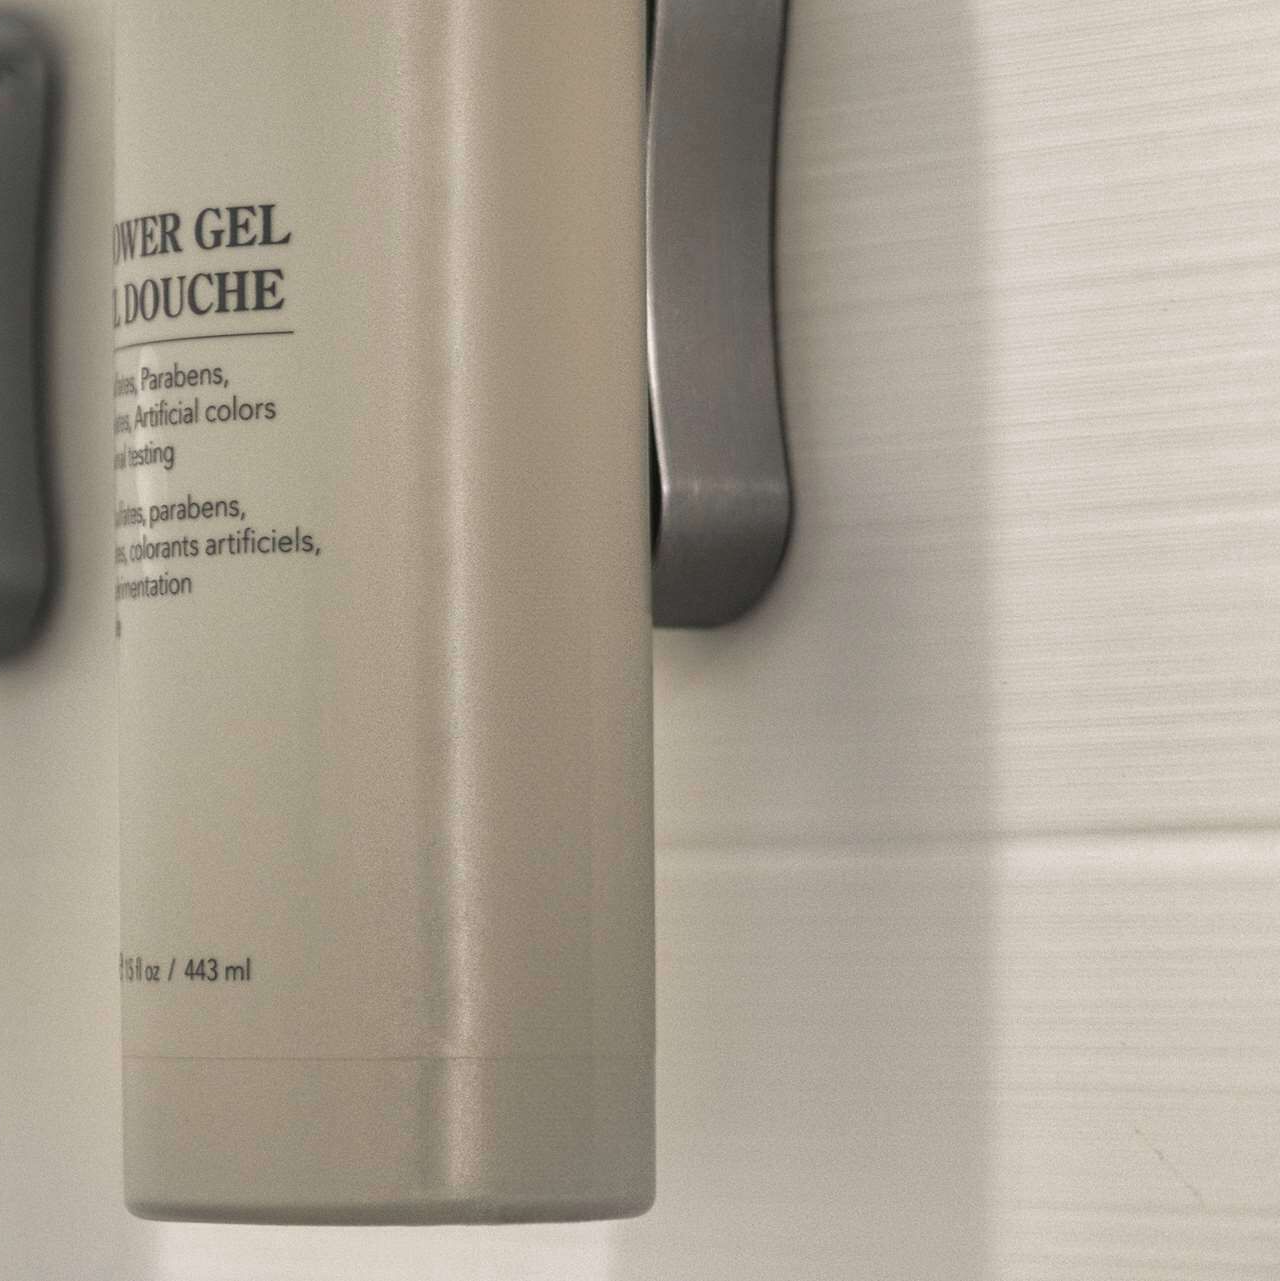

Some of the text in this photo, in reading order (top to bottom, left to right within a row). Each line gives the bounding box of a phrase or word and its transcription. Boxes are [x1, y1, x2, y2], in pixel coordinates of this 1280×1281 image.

[113, 203, 292, 265] OWER GEL
[124, 267, 285, 326] DOUCHE
[140, 362, 229, 391] Parabens,
[134, 397, 199, 431] Artificial
[205, 394, 277, 423] colors
[128, 440, 175, 471] testing
[149, 493, 246, 529] parabens,
[129, 534, 199, 563] colorants
[205, 526, 321, 557] artificiels,
[145, 964, 161, 982] oz
[168, 957, 176, 982] /
[184, 956, 219, 982] 443
[225, 957, 251, 982] ml
